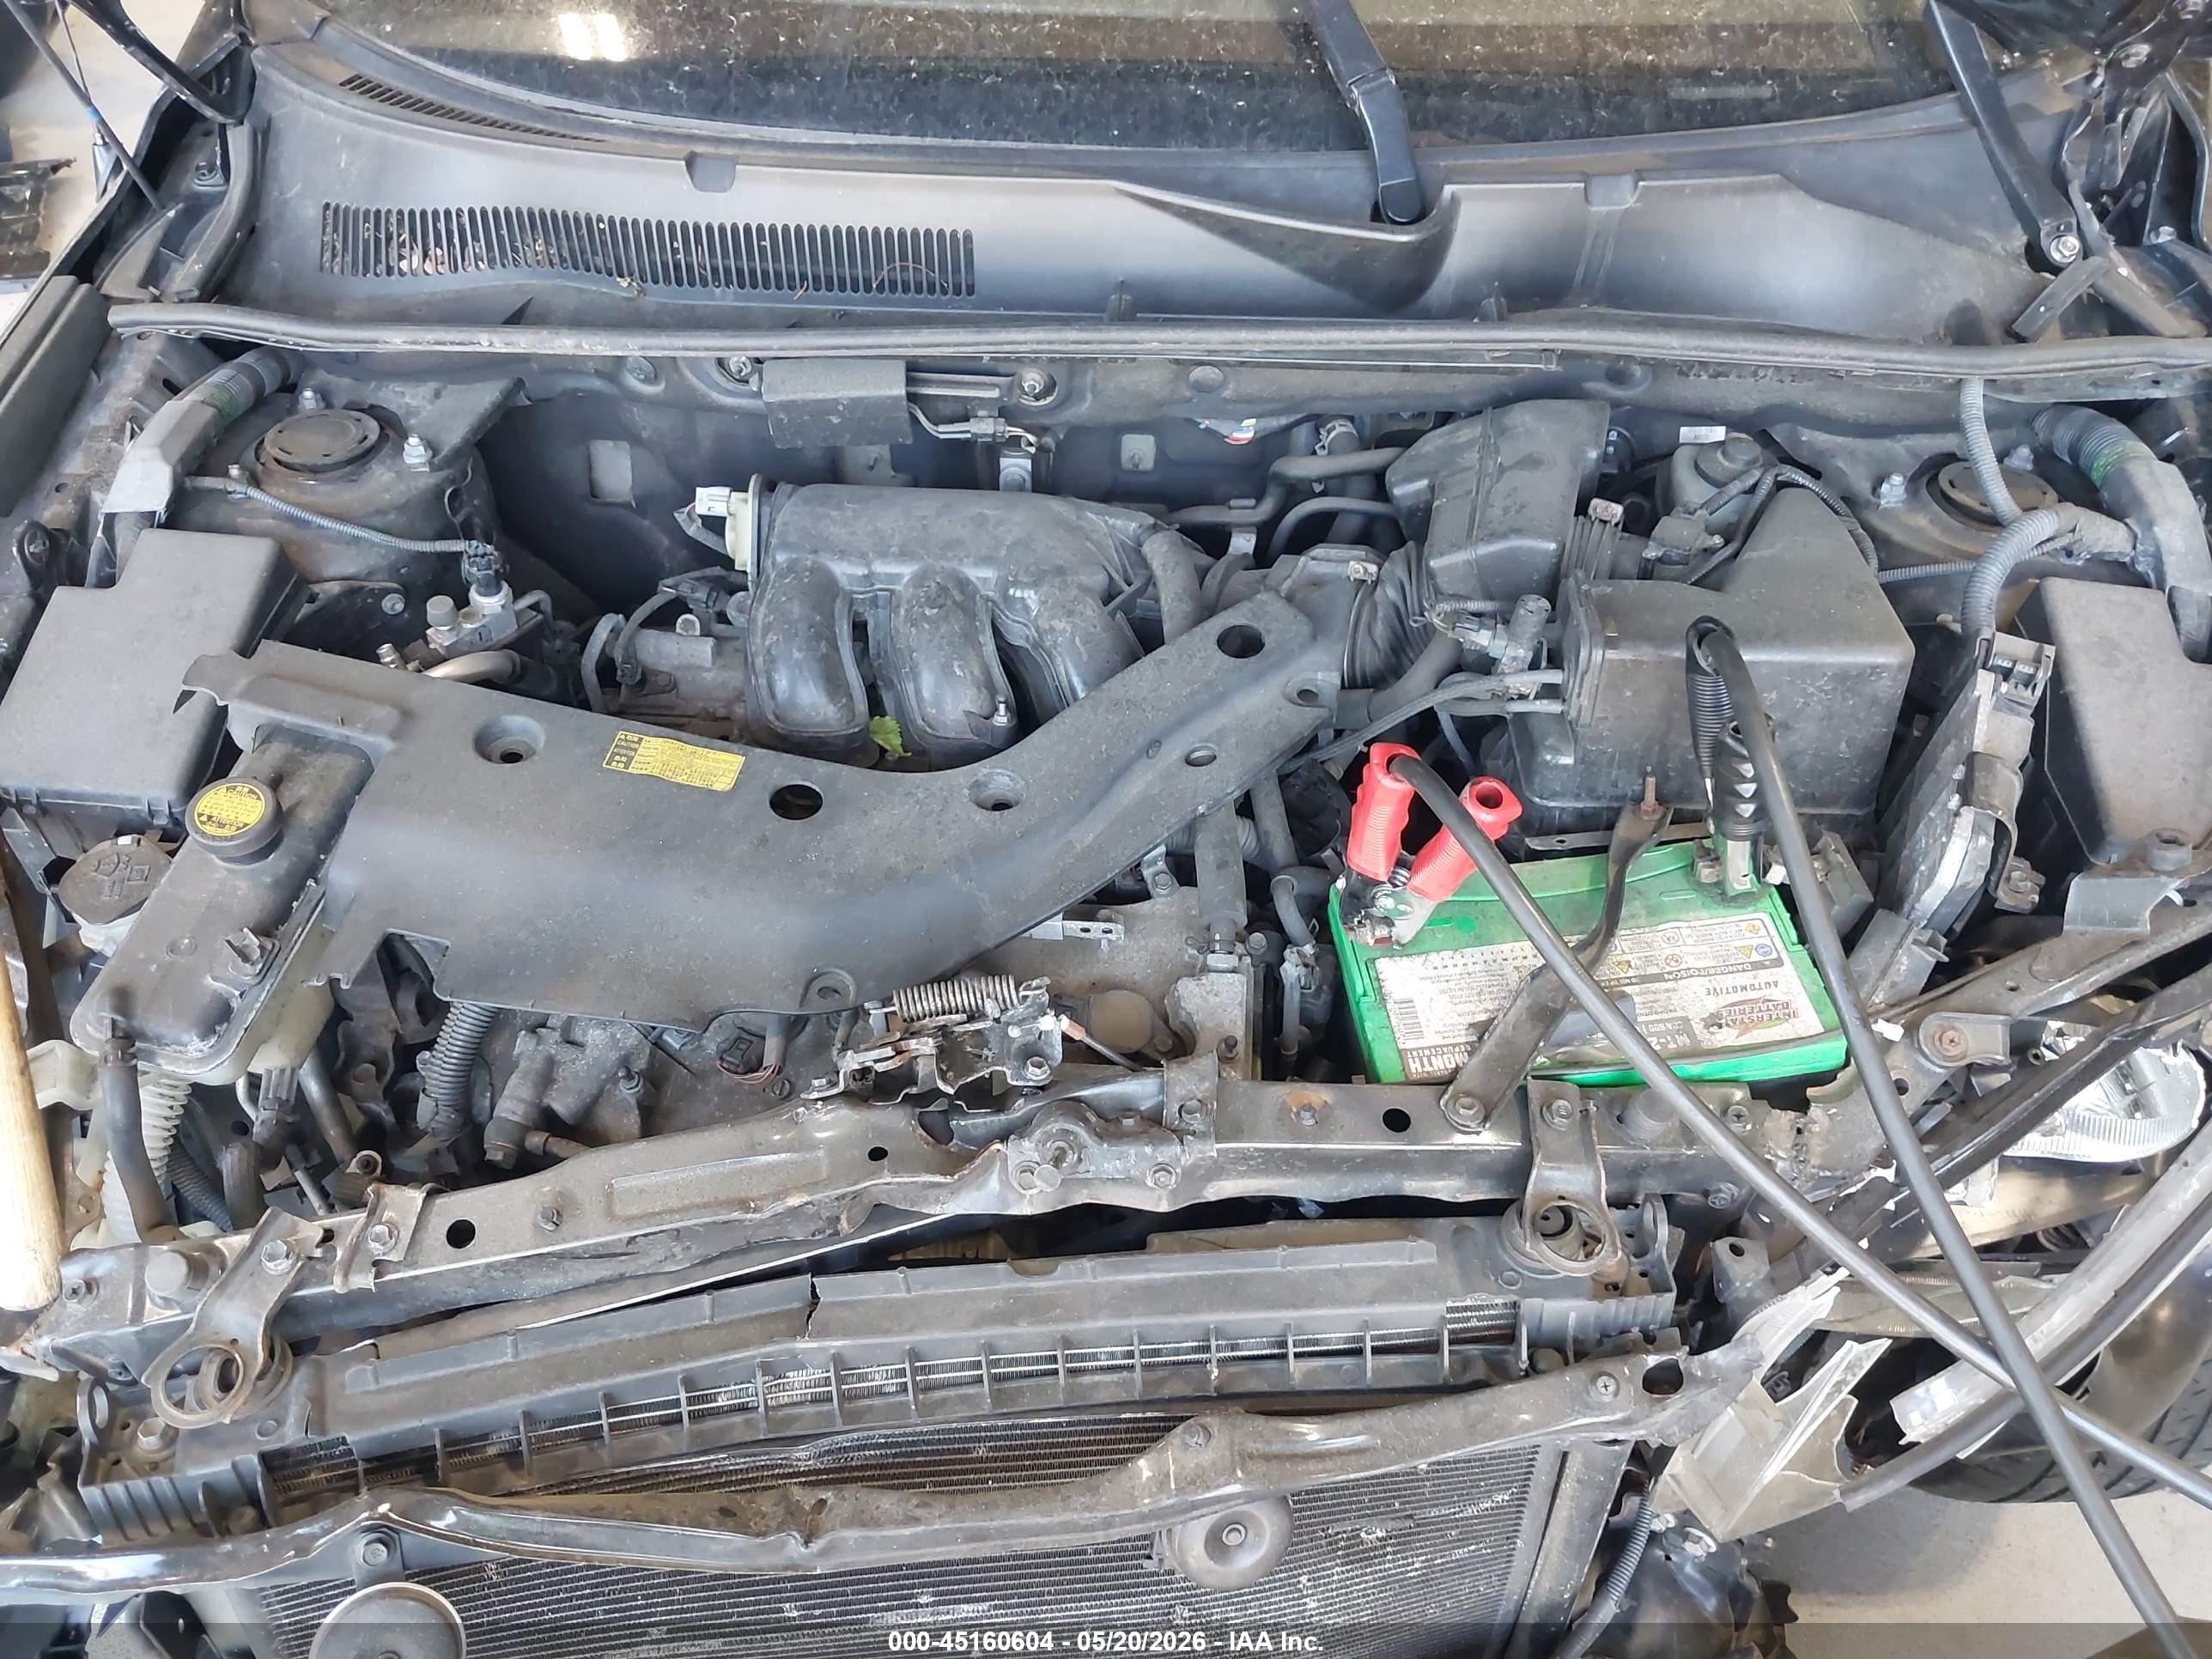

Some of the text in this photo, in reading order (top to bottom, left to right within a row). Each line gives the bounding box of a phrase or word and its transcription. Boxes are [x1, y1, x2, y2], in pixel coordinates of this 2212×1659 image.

[617, 740, 640, 750] CAUTION
[1662, 963, 1753, 981] DANGER/POISON
[1705, 980, 1779, 996] AUTOMOTIVE
[1716, 1000, 1791, 1018] BATTERIES
[1407, 1044, 1472, 1058] REPLACEMENT
[1407, 1052, 1470, 1073] MONTH
